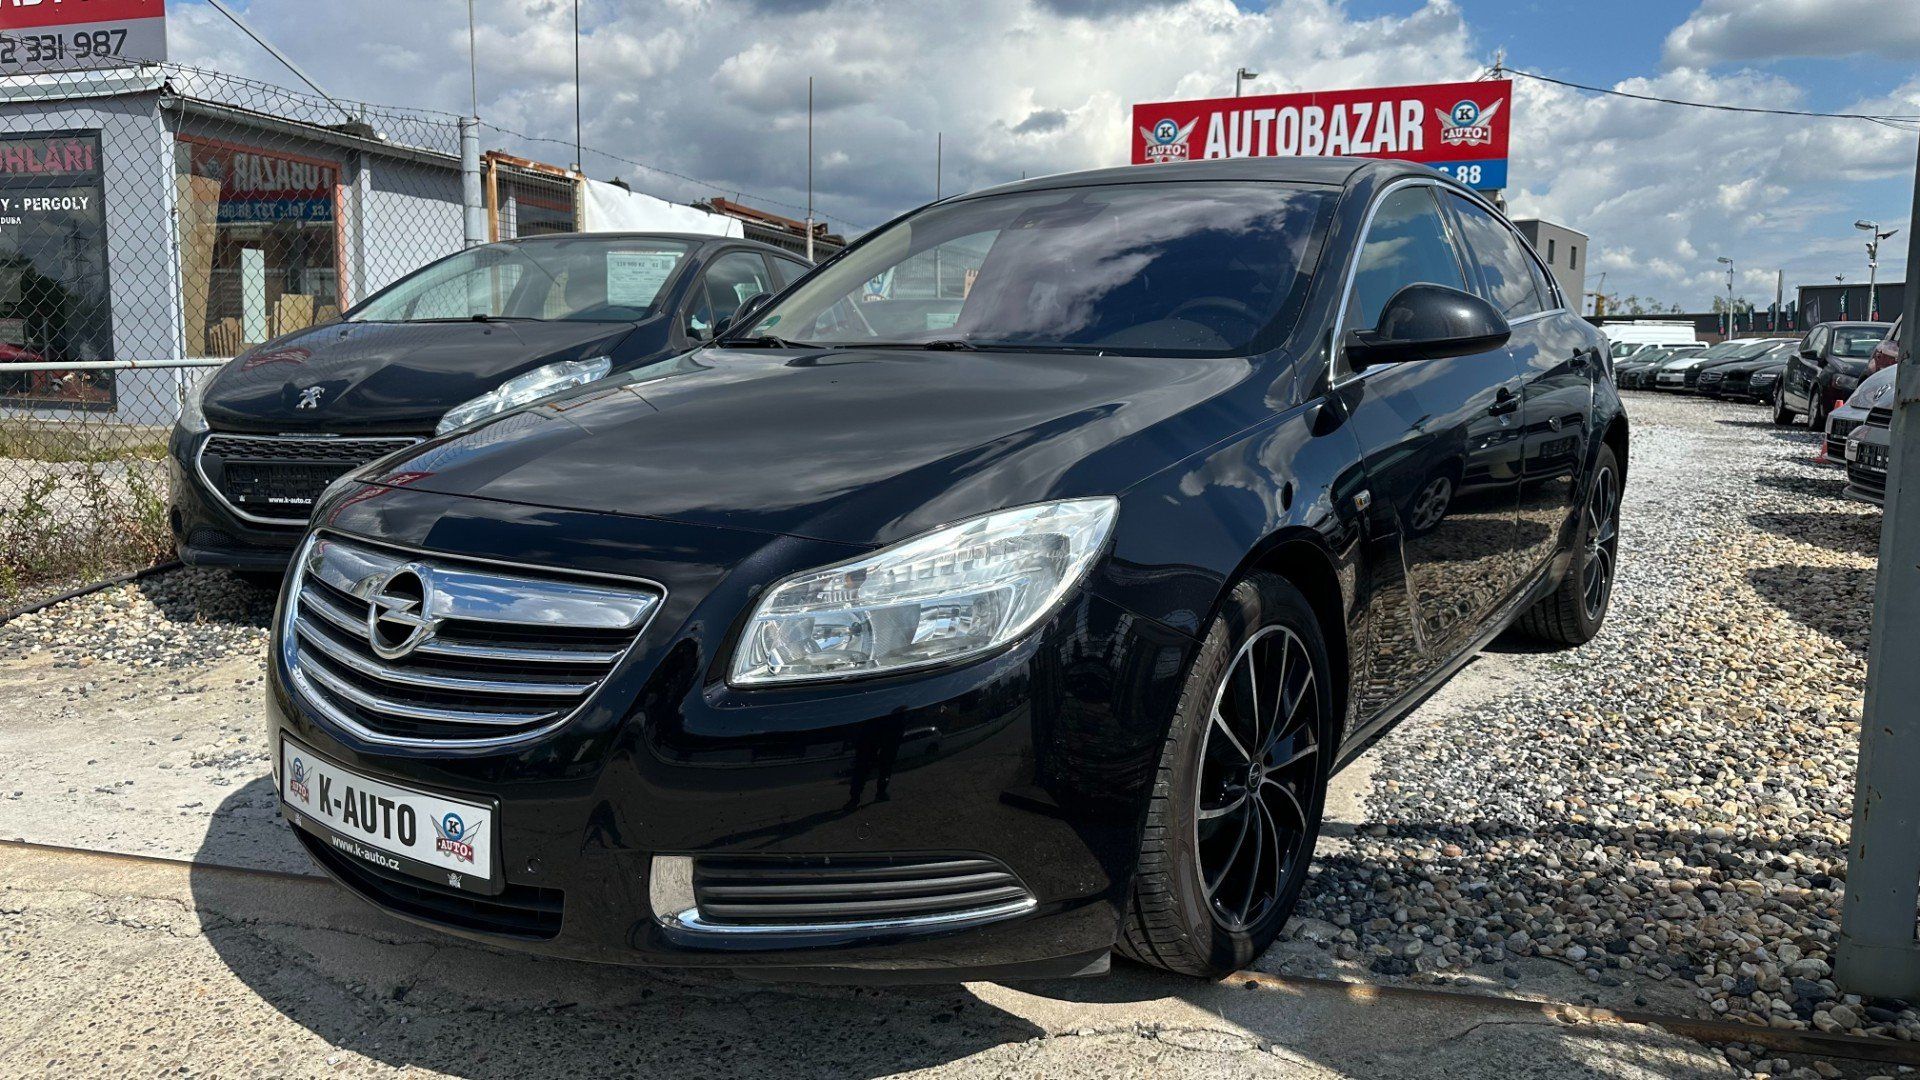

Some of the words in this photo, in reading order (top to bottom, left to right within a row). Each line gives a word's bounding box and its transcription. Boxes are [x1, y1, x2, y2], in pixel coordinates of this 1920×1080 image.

[25, 34, 64, 62] 331
[73, 28, 128, 59] 987
[1458, 108, 1472, 120] K
[1159, 126, 1172, 138] K
[1203, 99, 1424, 160] AUTOBAZAR
[1447, 127, 1482, 139] AUTO
[0, 139, 93, 173] HLÁŘI
[1150, 143, 1182, 156] AUTO
[1456, 165, 1481, 184] 88
[24, 196, 89, 211] PERGOLY
[268, 496, 312, 504] www.k-auto.cz
[318, 773, 417, 847] K-AUTO
[447, 820, 460, 834] K
[331, 835, 400, 871] www.k-auto.cz
[440, 839, 469, 857] AUTO
